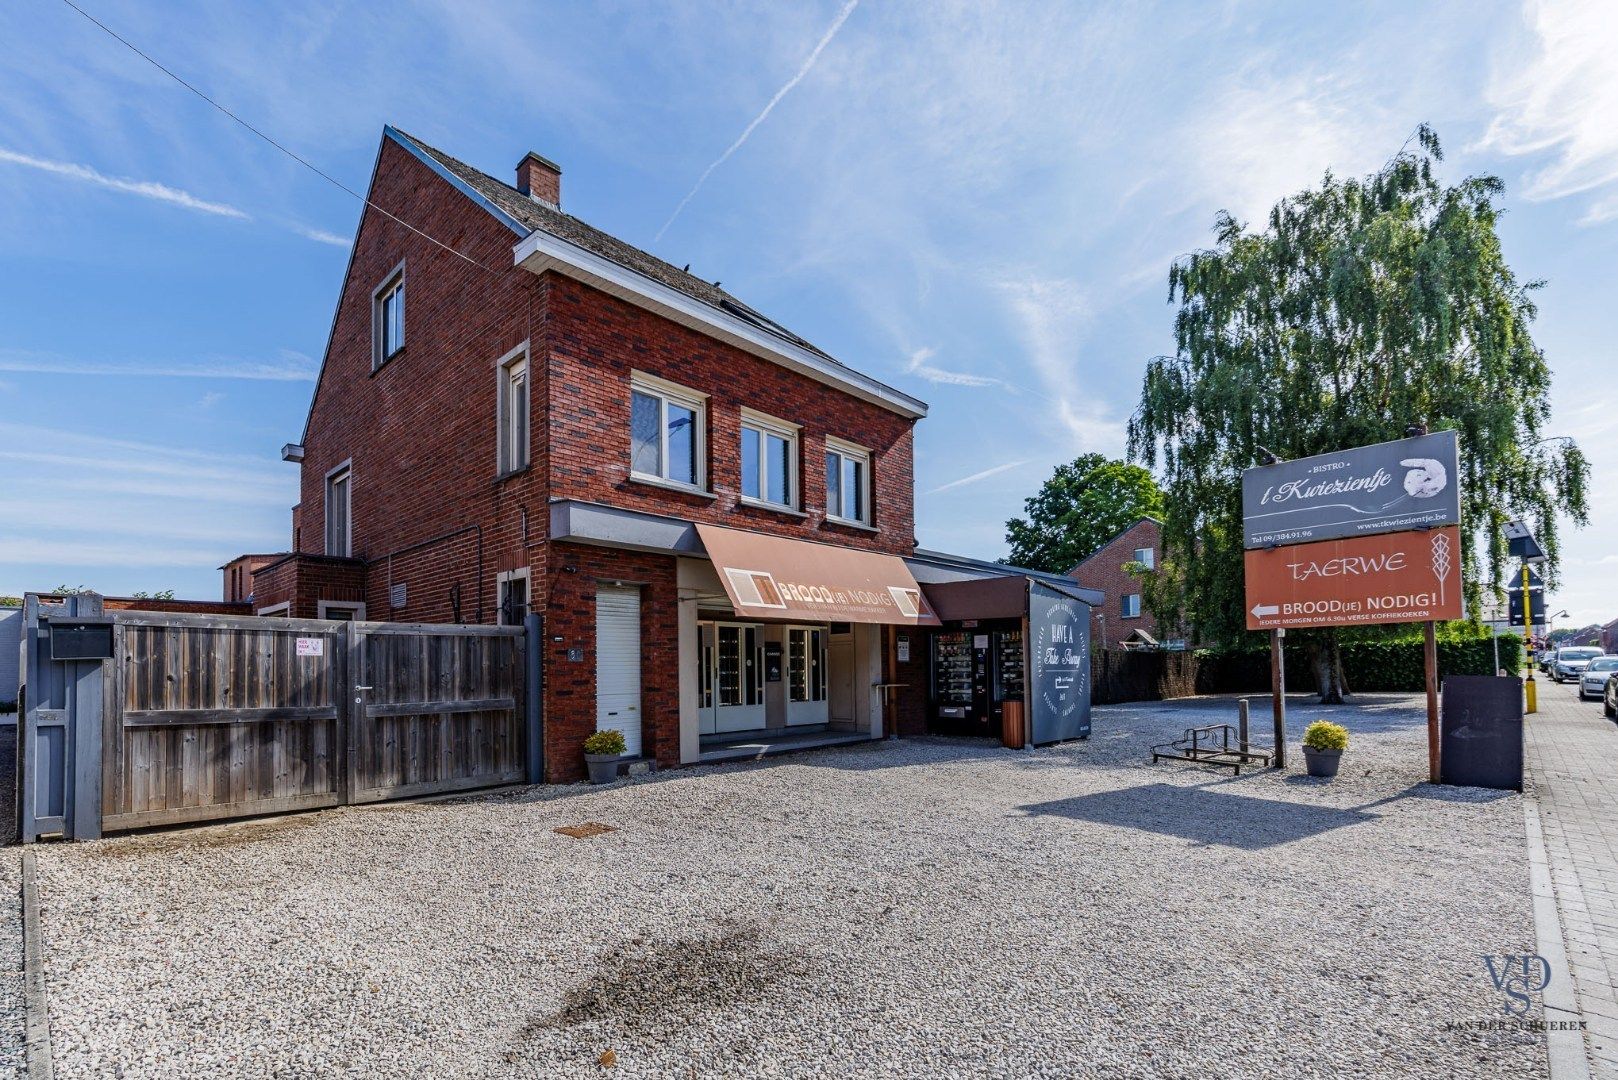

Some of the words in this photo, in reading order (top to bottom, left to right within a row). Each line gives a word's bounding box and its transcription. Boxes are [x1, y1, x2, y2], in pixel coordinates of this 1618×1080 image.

[1313, 461, 1345, 473] BISTRO
[1357, 513, 1447, 530] www.tkwiezientje.be
[1263, 530, 1312, 542] 09/384.91.96
[1286, 552, 1408, 581] TAERWE
[1283, 600, 1362, 615] BROOD(JE)
[1367, 593, 1437, 609] NODIG!
[1371, 610, 1430, 619] KOFFIEKOEKEN
[1051, 624, 1067, 643] HAVE
[1068, 626, 1074, 643] A
